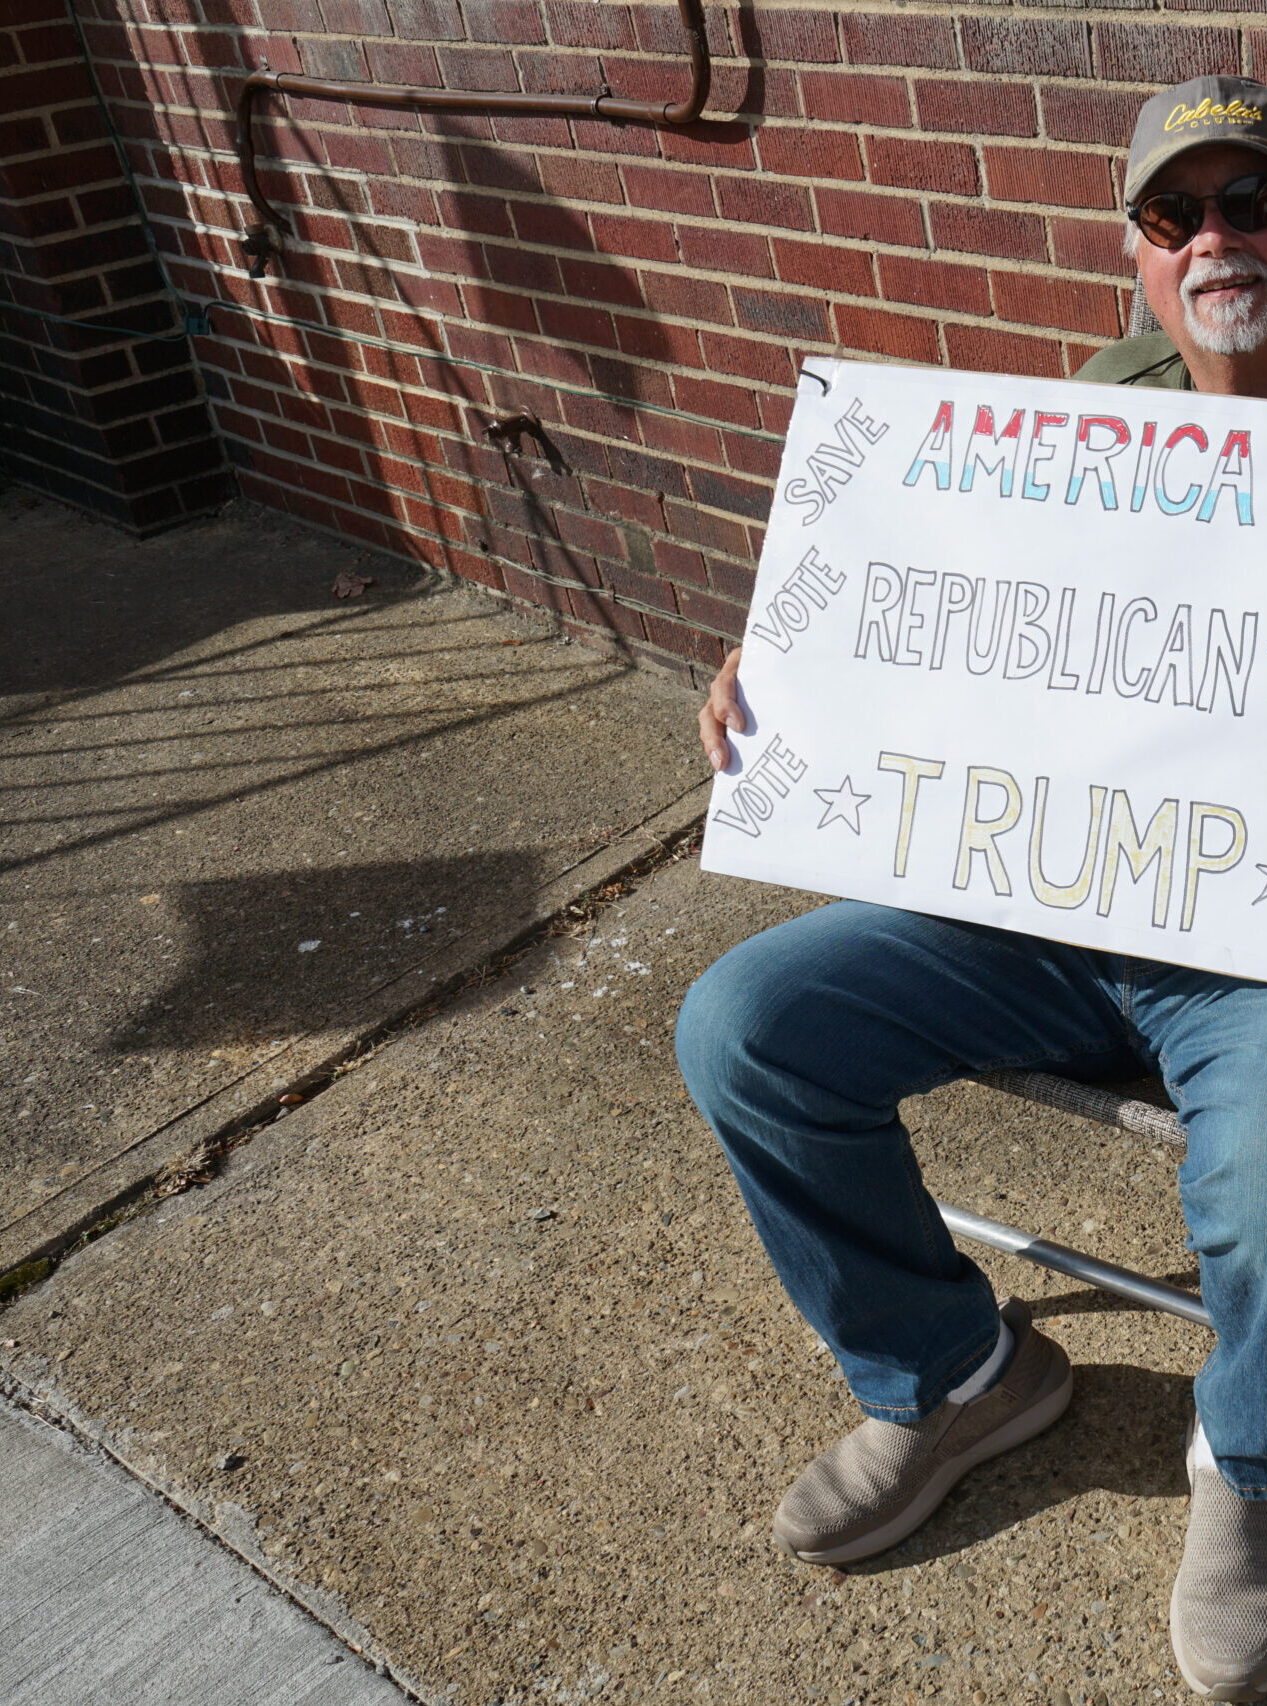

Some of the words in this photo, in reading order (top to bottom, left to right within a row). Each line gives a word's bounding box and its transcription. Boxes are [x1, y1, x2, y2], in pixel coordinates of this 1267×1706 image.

[1164, 97, 1263, 131] Cabela's
[784, 397, 890, 526] SAVE
[750, 545, 847, 654] VOTE
[853, 561, 1259, 716] REPUBLICAN
[713, 733, 808, 838] VOTE
[877, 751, 1248, 932] TRUMP
